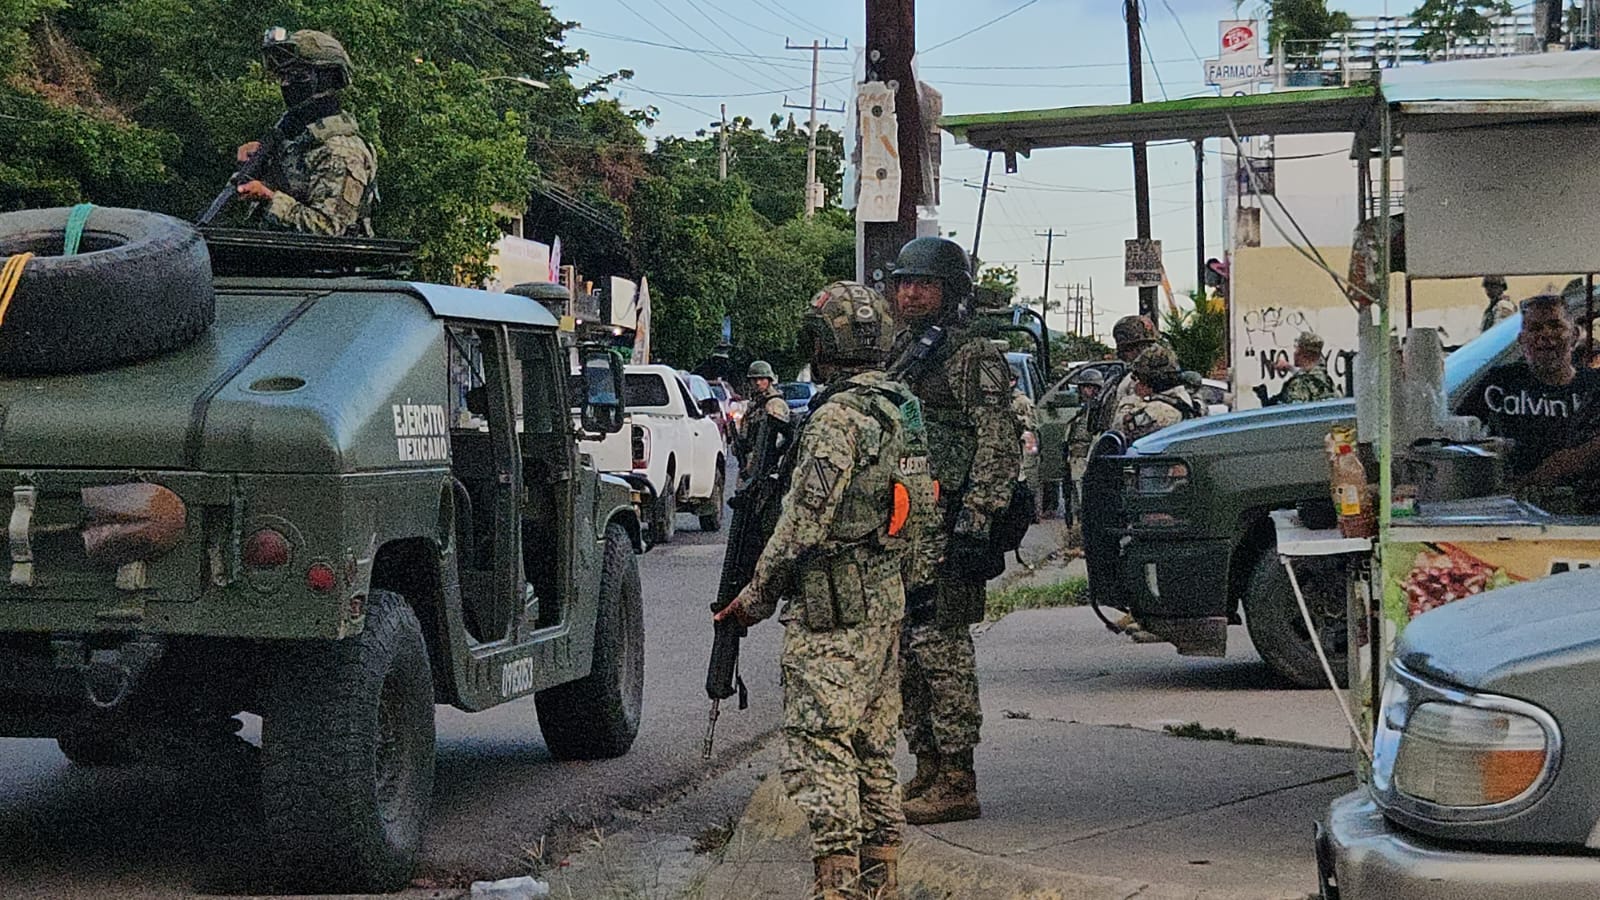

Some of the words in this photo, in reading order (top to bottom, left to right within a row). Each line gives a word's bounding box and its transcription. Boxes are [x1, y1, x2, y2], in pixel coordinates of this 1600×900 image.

[1209, 65, 1271, 78] FARMACIAS
[1484, 385, 1569, 418] Calvin
[392, 397, 446, 436] EJÉRCITO
[397, 436, 448, 461] MEXICANO
